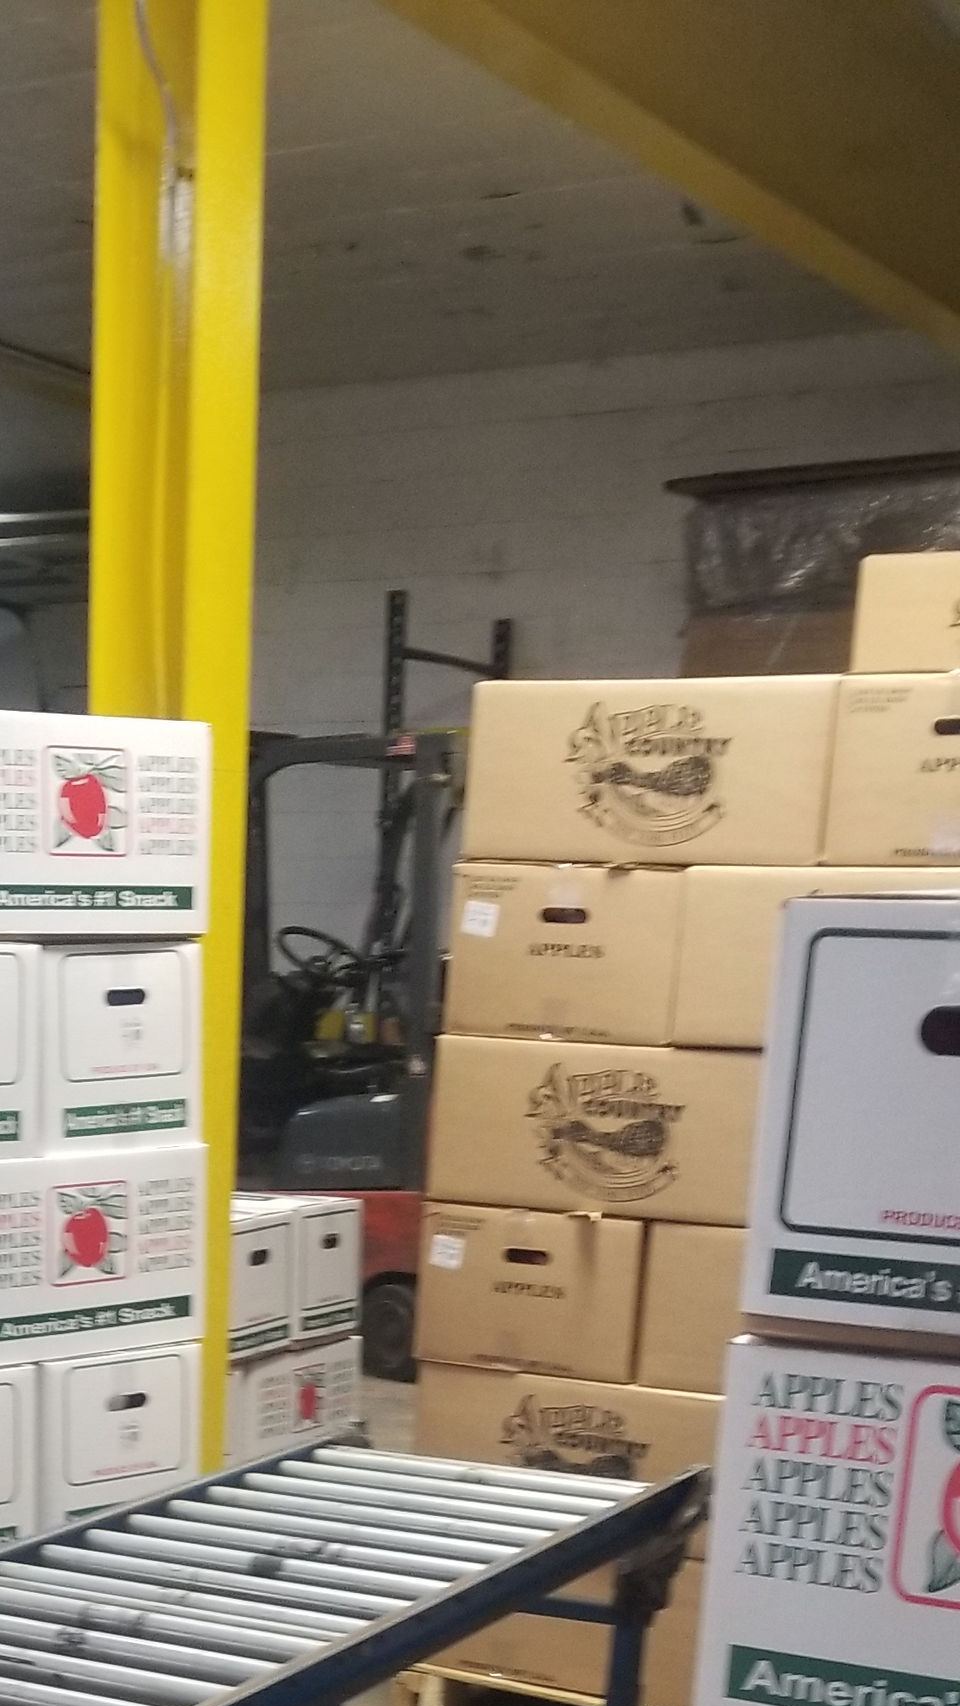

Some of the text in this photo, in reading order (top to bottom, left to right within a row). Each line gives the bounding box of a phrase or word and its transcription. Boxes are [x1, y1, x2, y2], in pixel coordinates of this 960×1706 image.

[794, 1261, 953, 1302] America's
[751, 1370, 904, 1422] APPLES
[745, 1414, 898, 1465] APPLES
[740, 1456, 894, 1508] APPLES
[738, 1498, 890, 1550] APPLES
[734, 1541, 883, 1594] APPLES
